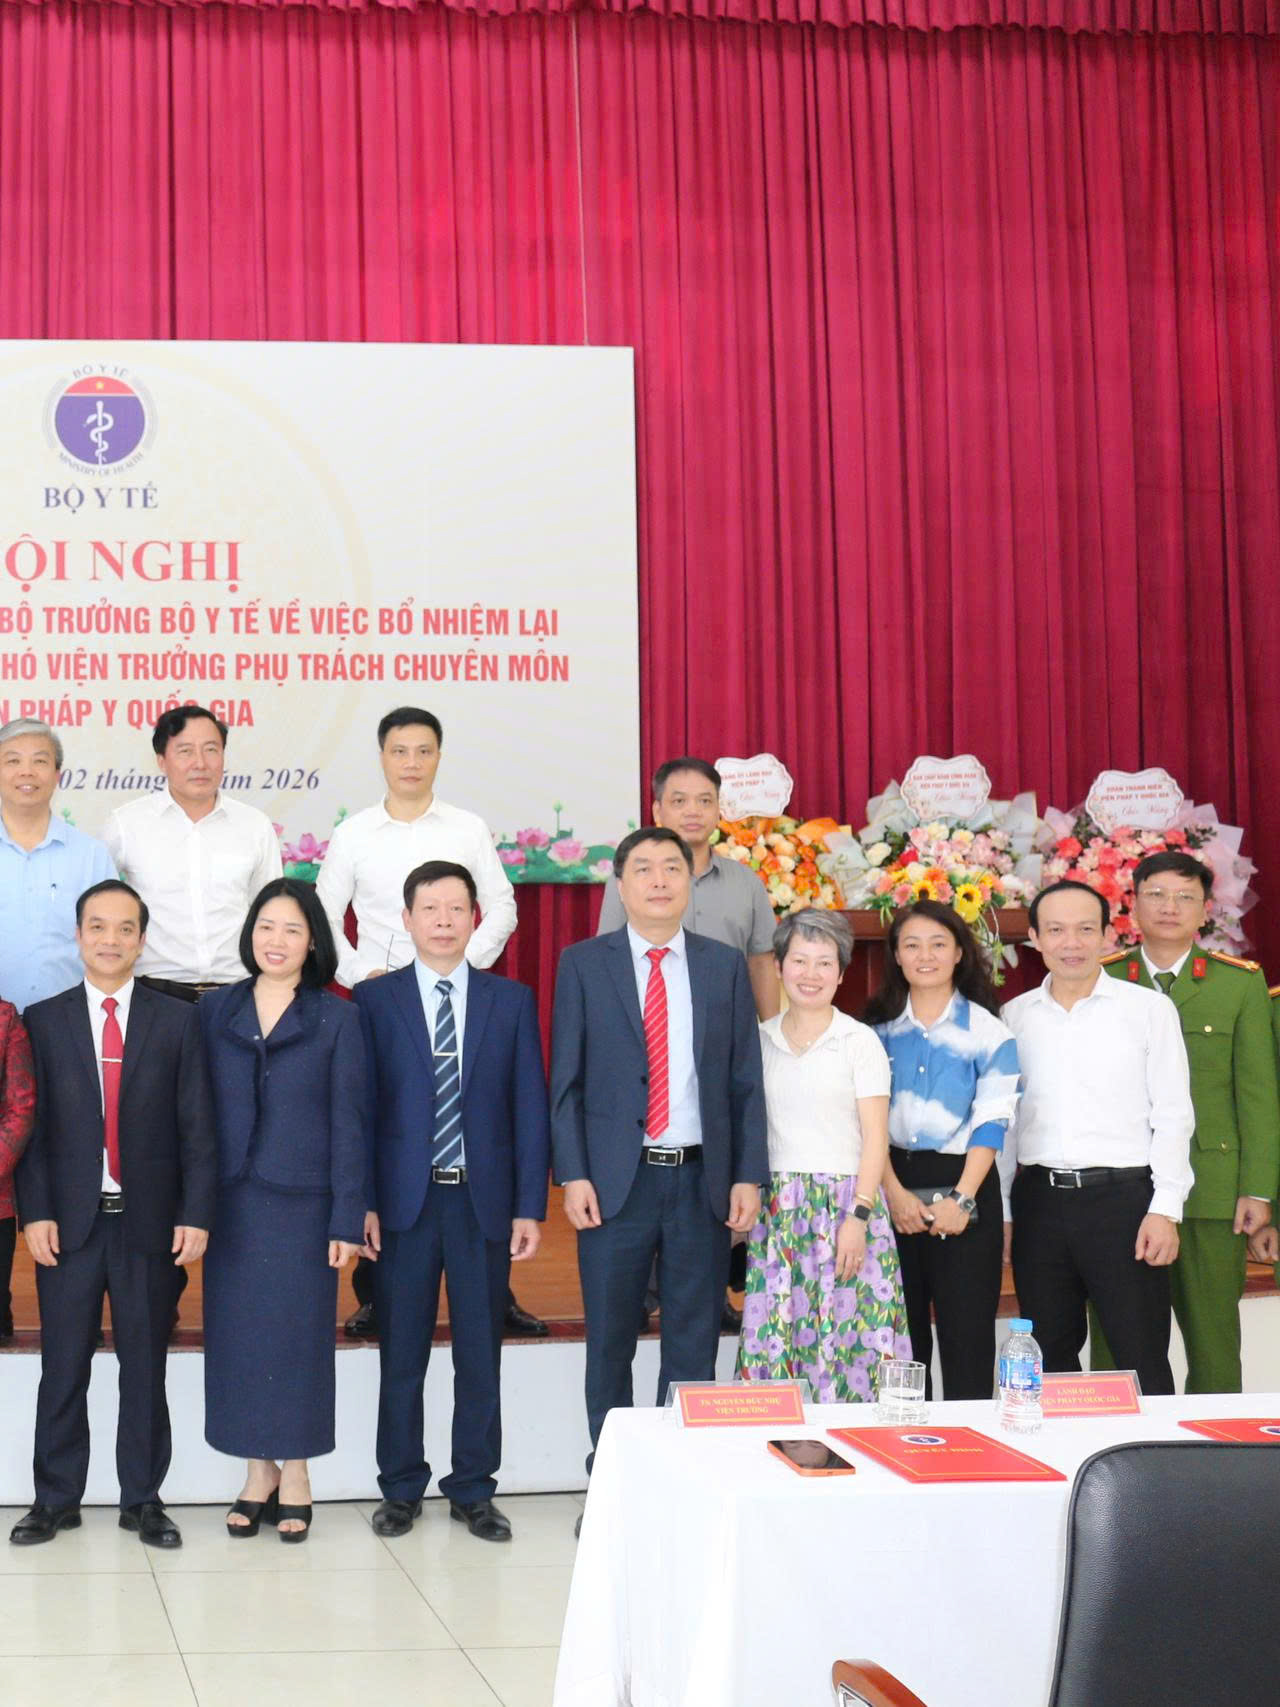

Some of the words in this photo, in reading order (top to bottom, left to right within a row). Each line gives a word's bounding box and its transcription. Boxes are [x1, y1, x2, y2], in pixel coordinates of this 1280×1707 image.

[44, 483, 85, 514] BỘ
[94, 487, 113, 509] Y
[120, 481, 158, 509] TẾ
[89, 540, 242, 593] NGHỊ
[43, 598, 151, 635] TRƯỞNG
[160, 601, 196, 640] BỘ
[205, 607, 221, 635] Y
[229, 598, 261, 635] TẾ
[269, 598, 302, 635] VỀ
[310, 603, 369, 640] VIỆC
[378, 597, 415, 635] BỔ
[422, 603, 510, 640] NHIỆM
[518, 608, 559, 642] LẠI
[48, 646, 109, 686] VIỆN
[117, 644, 227, 682] TRƯỞNG
[234, 652, 289, 687] PHỤ
[298, 648, 385, 682] TRÁCH
[394, 650, 499, 682] CHUYÊN
[508, 648, 570, 683] MÔN
[19, 694, 92, 727] PHÁP
[101, 699, 118, 727] Y
[209, 699, 255, 727] GIA
[59, 768, 87, 790] 02
[95, 768, 168, 794] tháng
[261, 768, 320, 790] 2026
